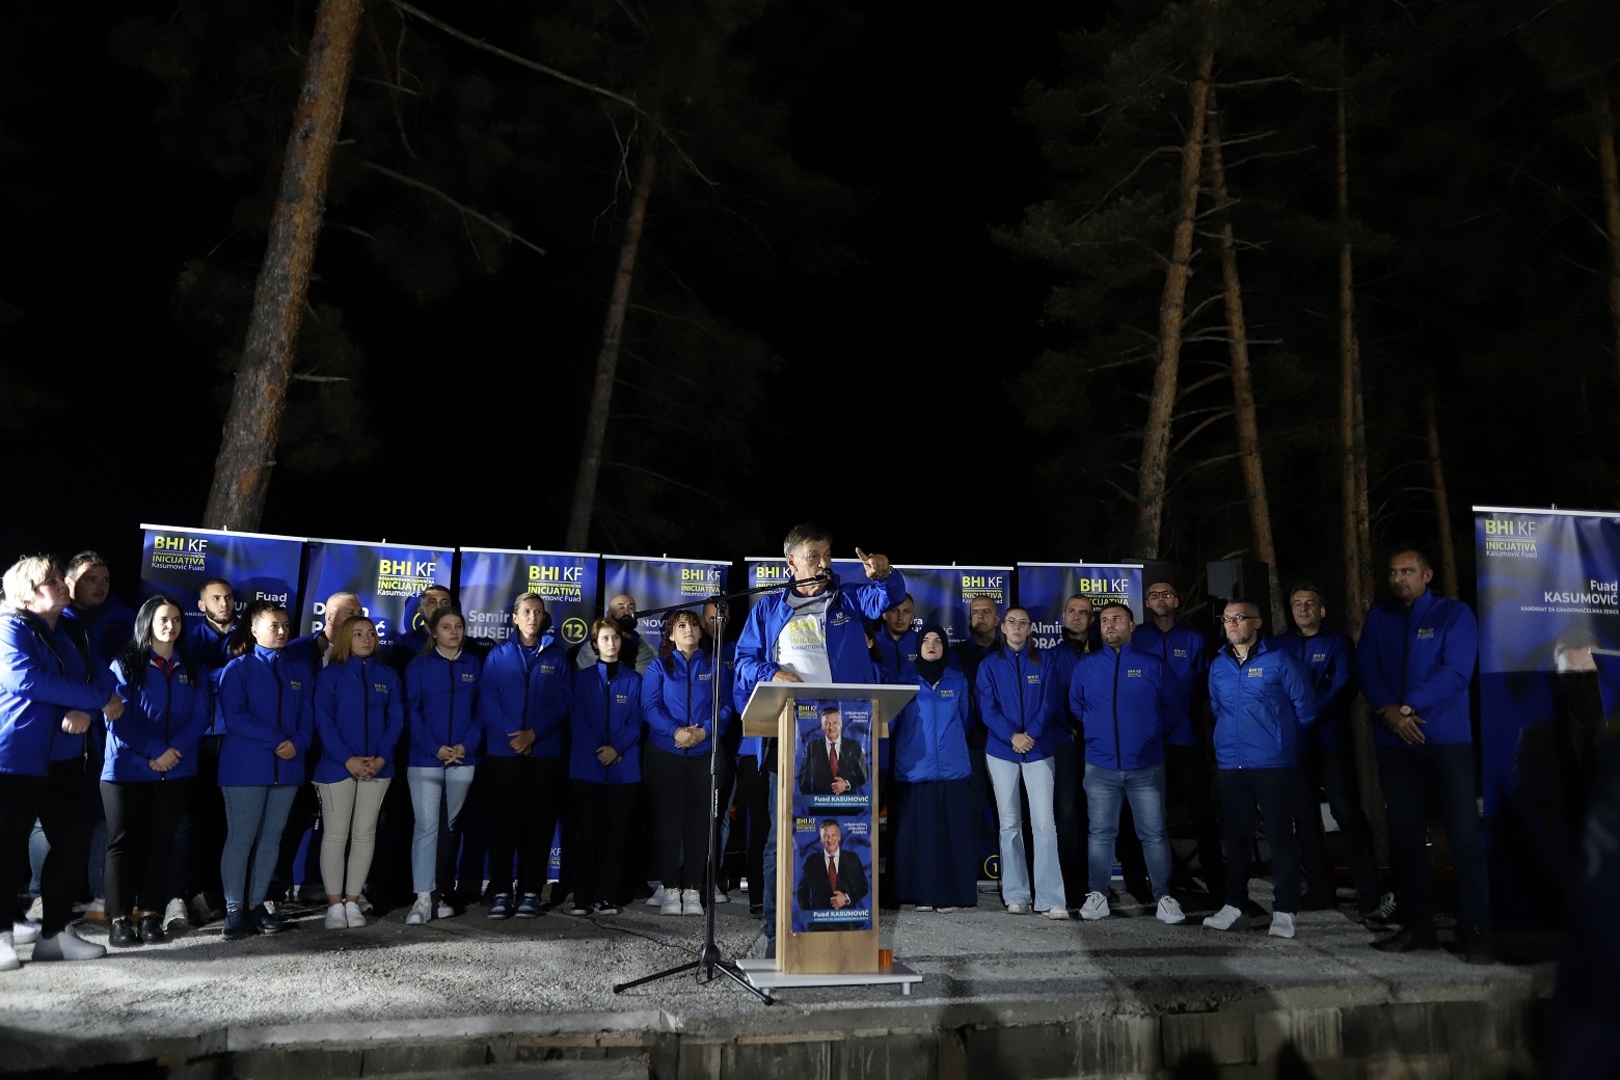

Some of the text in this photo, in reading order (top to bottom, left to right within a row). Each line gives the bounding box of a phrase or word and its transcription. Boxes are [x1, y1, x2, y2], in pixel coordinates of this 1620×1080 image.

[1485, 520, 1536, 536] BHI KF
[154, 536, 208, 551] BHI KF
[1486, 542, 1536, 551] INICIJATIVA
[379, 560, 436, 576] BHI KF
[529, 566, 583, 581] BHI KF
[756, 566, 780, 578] BHI
[681, 569, 721, 581] BHI KF
[962, 576, 1003, 588] BHI KF
[1080, 578, 1129, 593] BHI KF
[1590, 580, 1618, 591] Fuad
[256, 592, 287, 602] Fuad
[528, 587, 581, 596] INICIJATIVA
[1544, 592, 1618, 605] KASUMOVIĆ
[565, 624, 583, 638] 12
[789, 617, 816, 633] BHI
